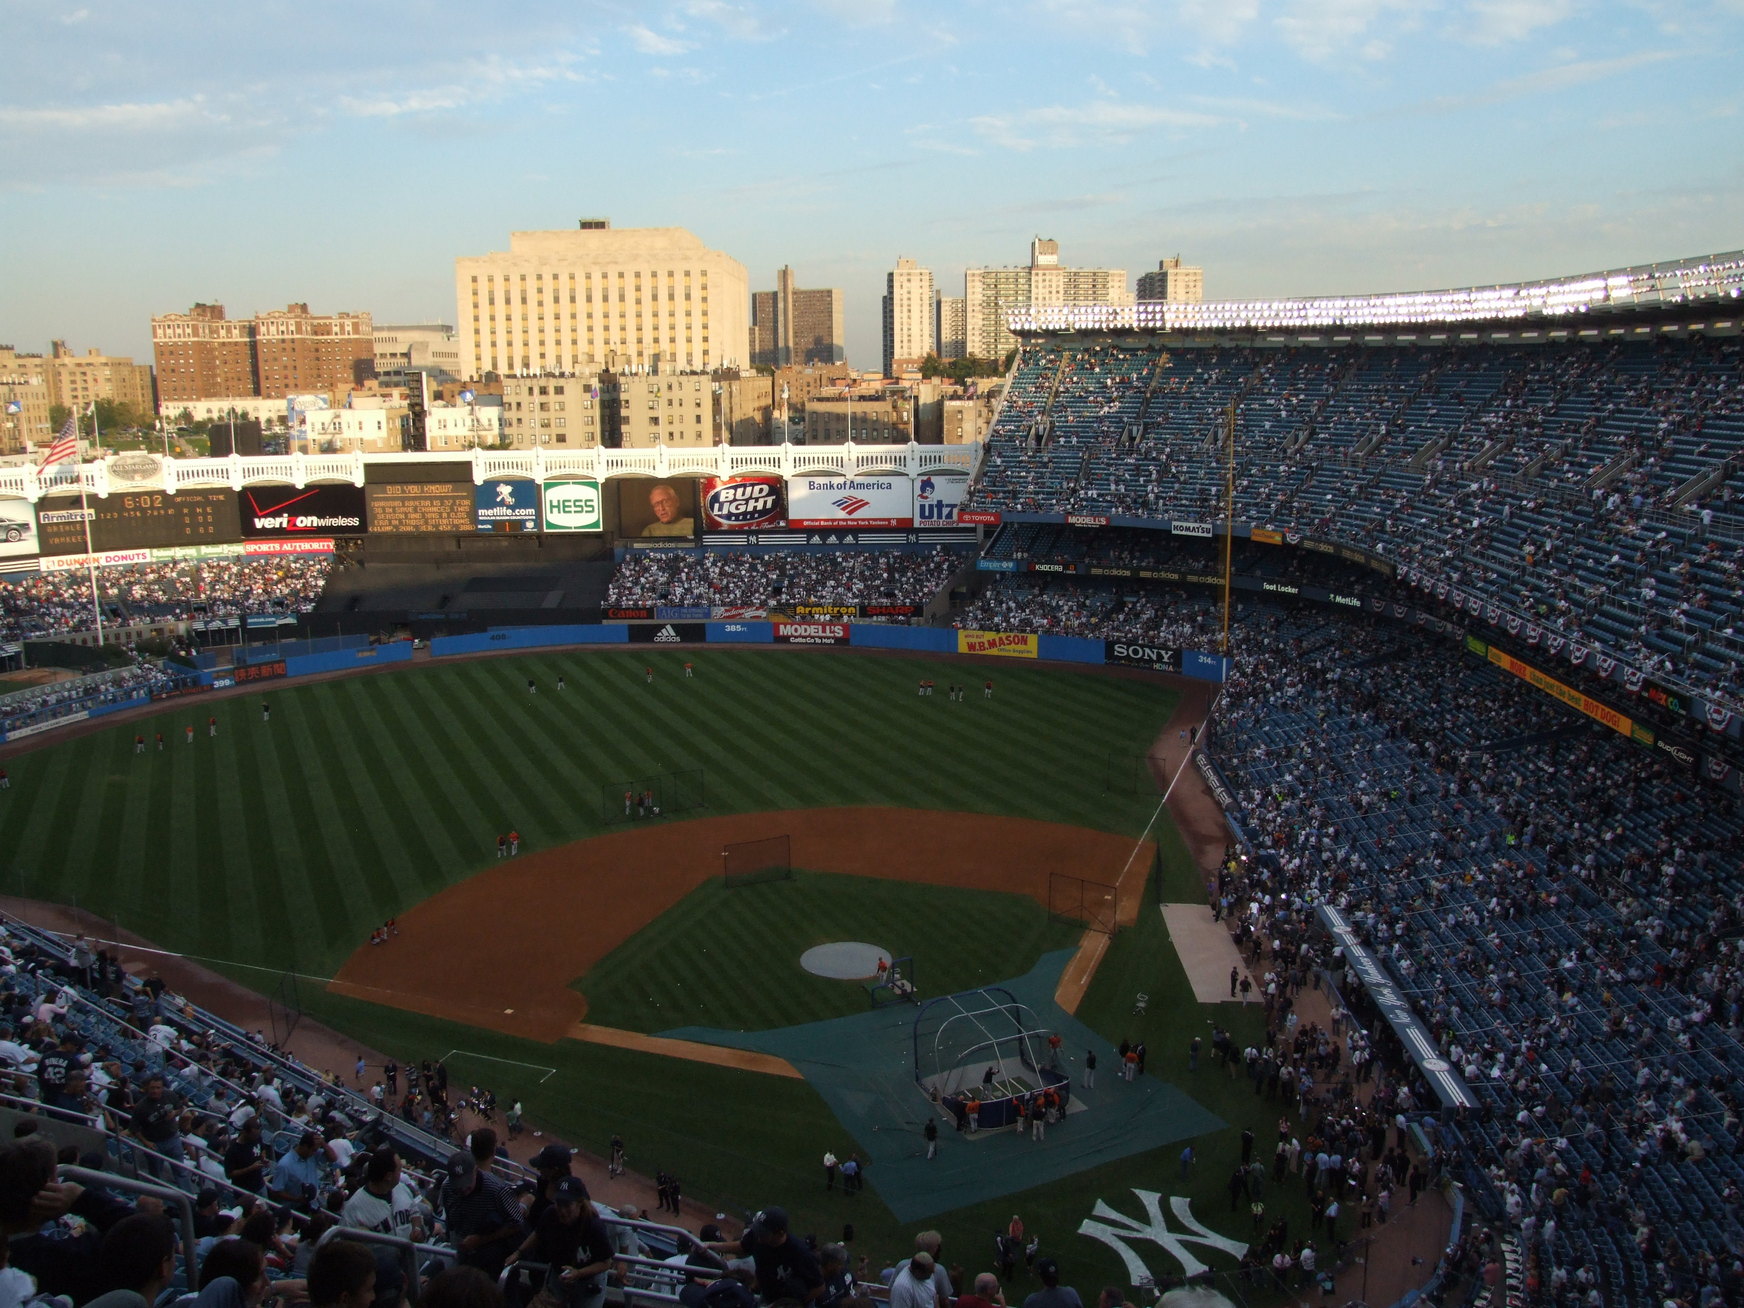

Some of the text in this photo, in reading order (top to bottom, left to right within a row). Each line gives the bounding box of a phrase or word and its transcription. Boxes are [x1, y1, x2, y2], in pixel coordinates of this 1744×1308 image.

[386, 484, 453, 494] DID YOU KNOW?
[808, 480, 892, 491] Bank of America
[719, 484, 770, 502] BUD
[124, 495, 162, 509] 6:02
[549, 499, 595, 514] HESS
[713, 495, 777, 515] LIGHT
[478, 506, 535, 516] metlife.com
[42, 512, 94, 522] Armitron
[253, 513, 360, 530] verizon wireless
[971, 514, 995, 522] TOYOTA
[1068, 516, 1106, 525] MODELL'S
[1172, 524, 1211, 535] KOMATSU
[245, 541, 335, 553] SPORTS AUTHORITY
[105, 552, 147, 563] DONUTS
[1103, 567, 1131, 577] adidas
[1152, 570, 1179, 580] adidas
[1198, 574, 1226, 585] adidas
[1278, 584, 1299, 594] Locker
[1335, 594, 1361, 607] MetLife
[608, 608, 648, 618] Canon
[661, 608, 678, 618] AIG
[795, 605, 856, 615] Armitron
[866, 606, 915, 615] SHARP
[724, 624, 742, 632] 385
[779, 624, 844, 637] MODELL'S
[489, 633, 506, 641] 408
[1113, 643, 1174, 663] SONY
[1198, 655, 1211, 665] 314
[213, 678, 230, 689] 399
[1509, 658, 1527, 678] MORE
[1583, 697, 1600, 716] HOT
[1600, 706, 1621, 728] DOG!
[1657, 740, 1695, 764] BUD LIGHT
[391, 1208, 411, 1223] YOR
